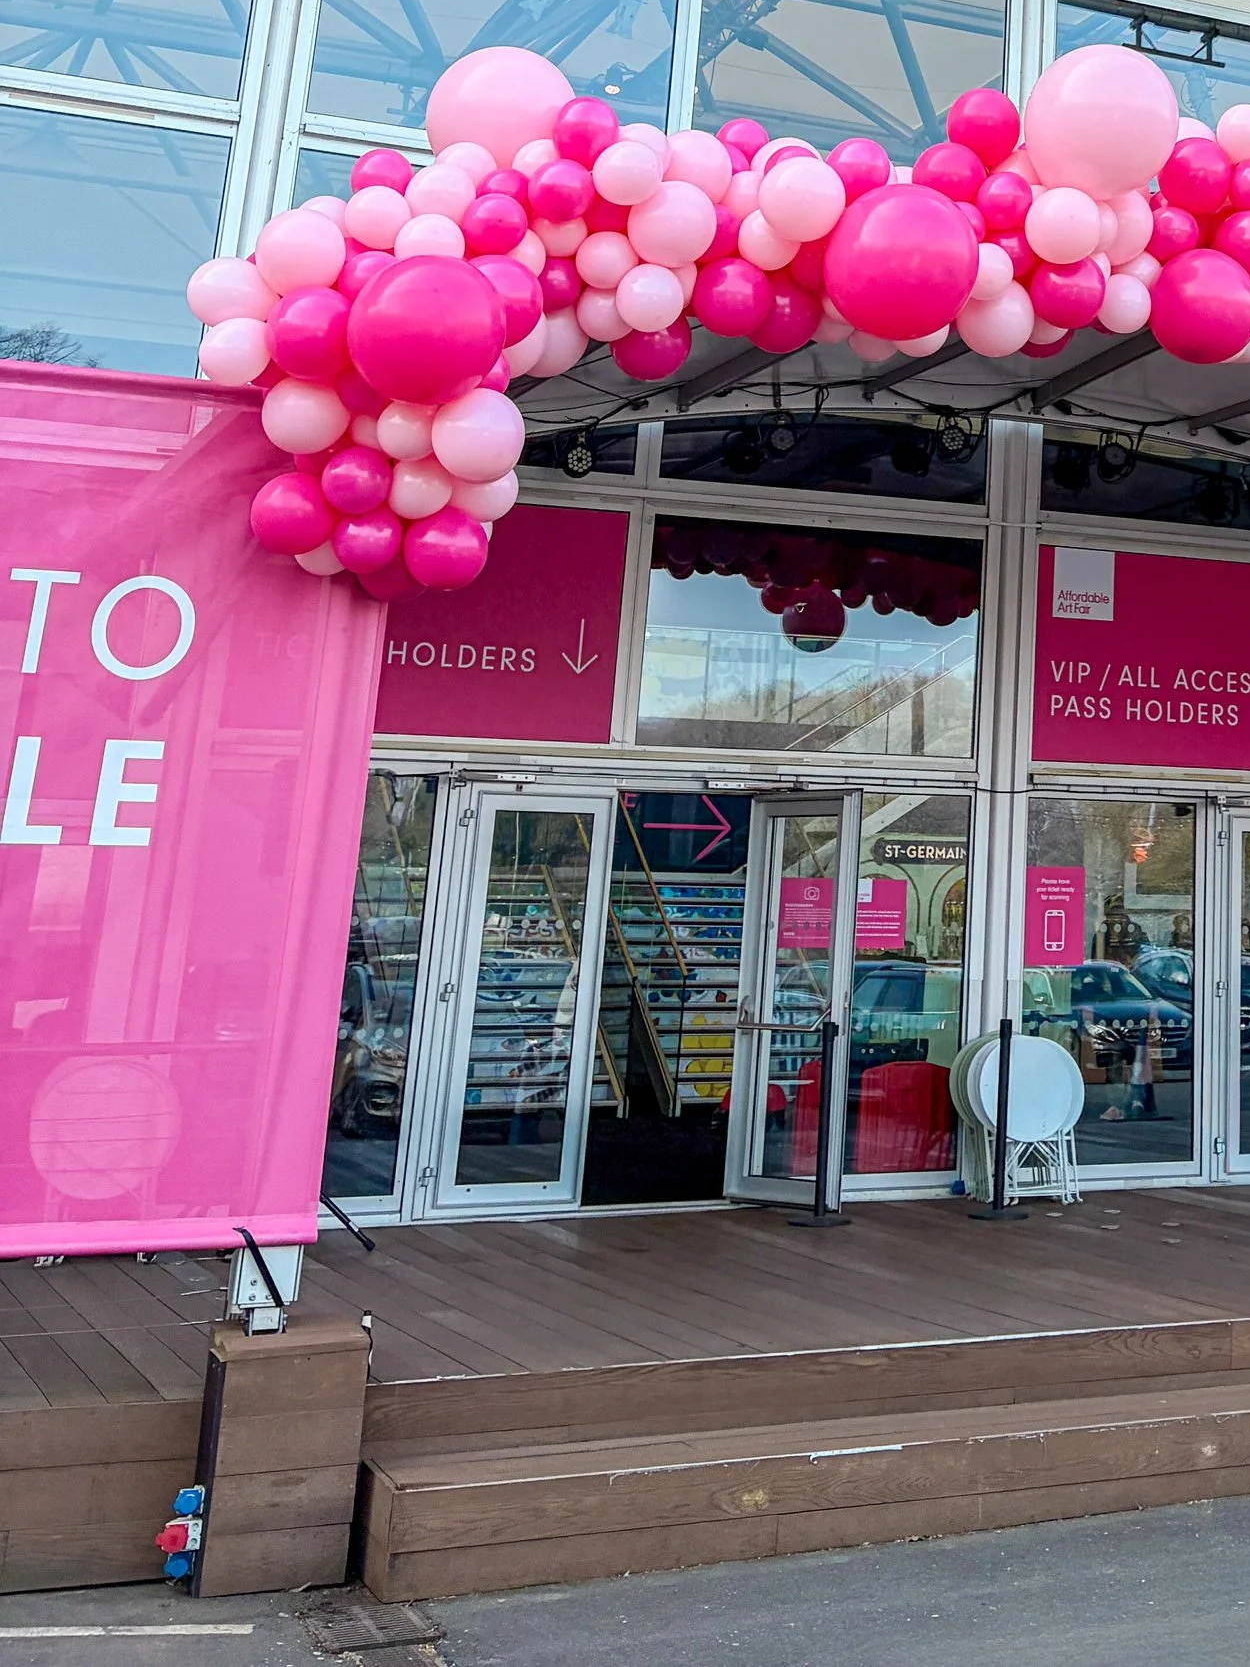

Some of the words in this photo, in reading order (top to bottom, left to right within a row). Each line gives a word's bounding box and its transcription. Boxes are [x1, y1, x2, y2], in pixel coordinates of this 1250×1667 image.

[1057, 589, 1110, 604] Affordable
[1057, 601, 1073, 614] Art
[1073, 602, 1092, 615] Fair
[10, 568, 196, 680] TO
[387, 640, 536, 673] HOLDERS
[1050, 660, 1092, 684] VIP
[1098, 663, 1112, 692] /
[1117, 664, 1161, 689] ALL
[1050, 694, 1112, 720] PASS
[1125, 698, 1240, 727] HOLDERS
[0, 736, 165, 847] LE
